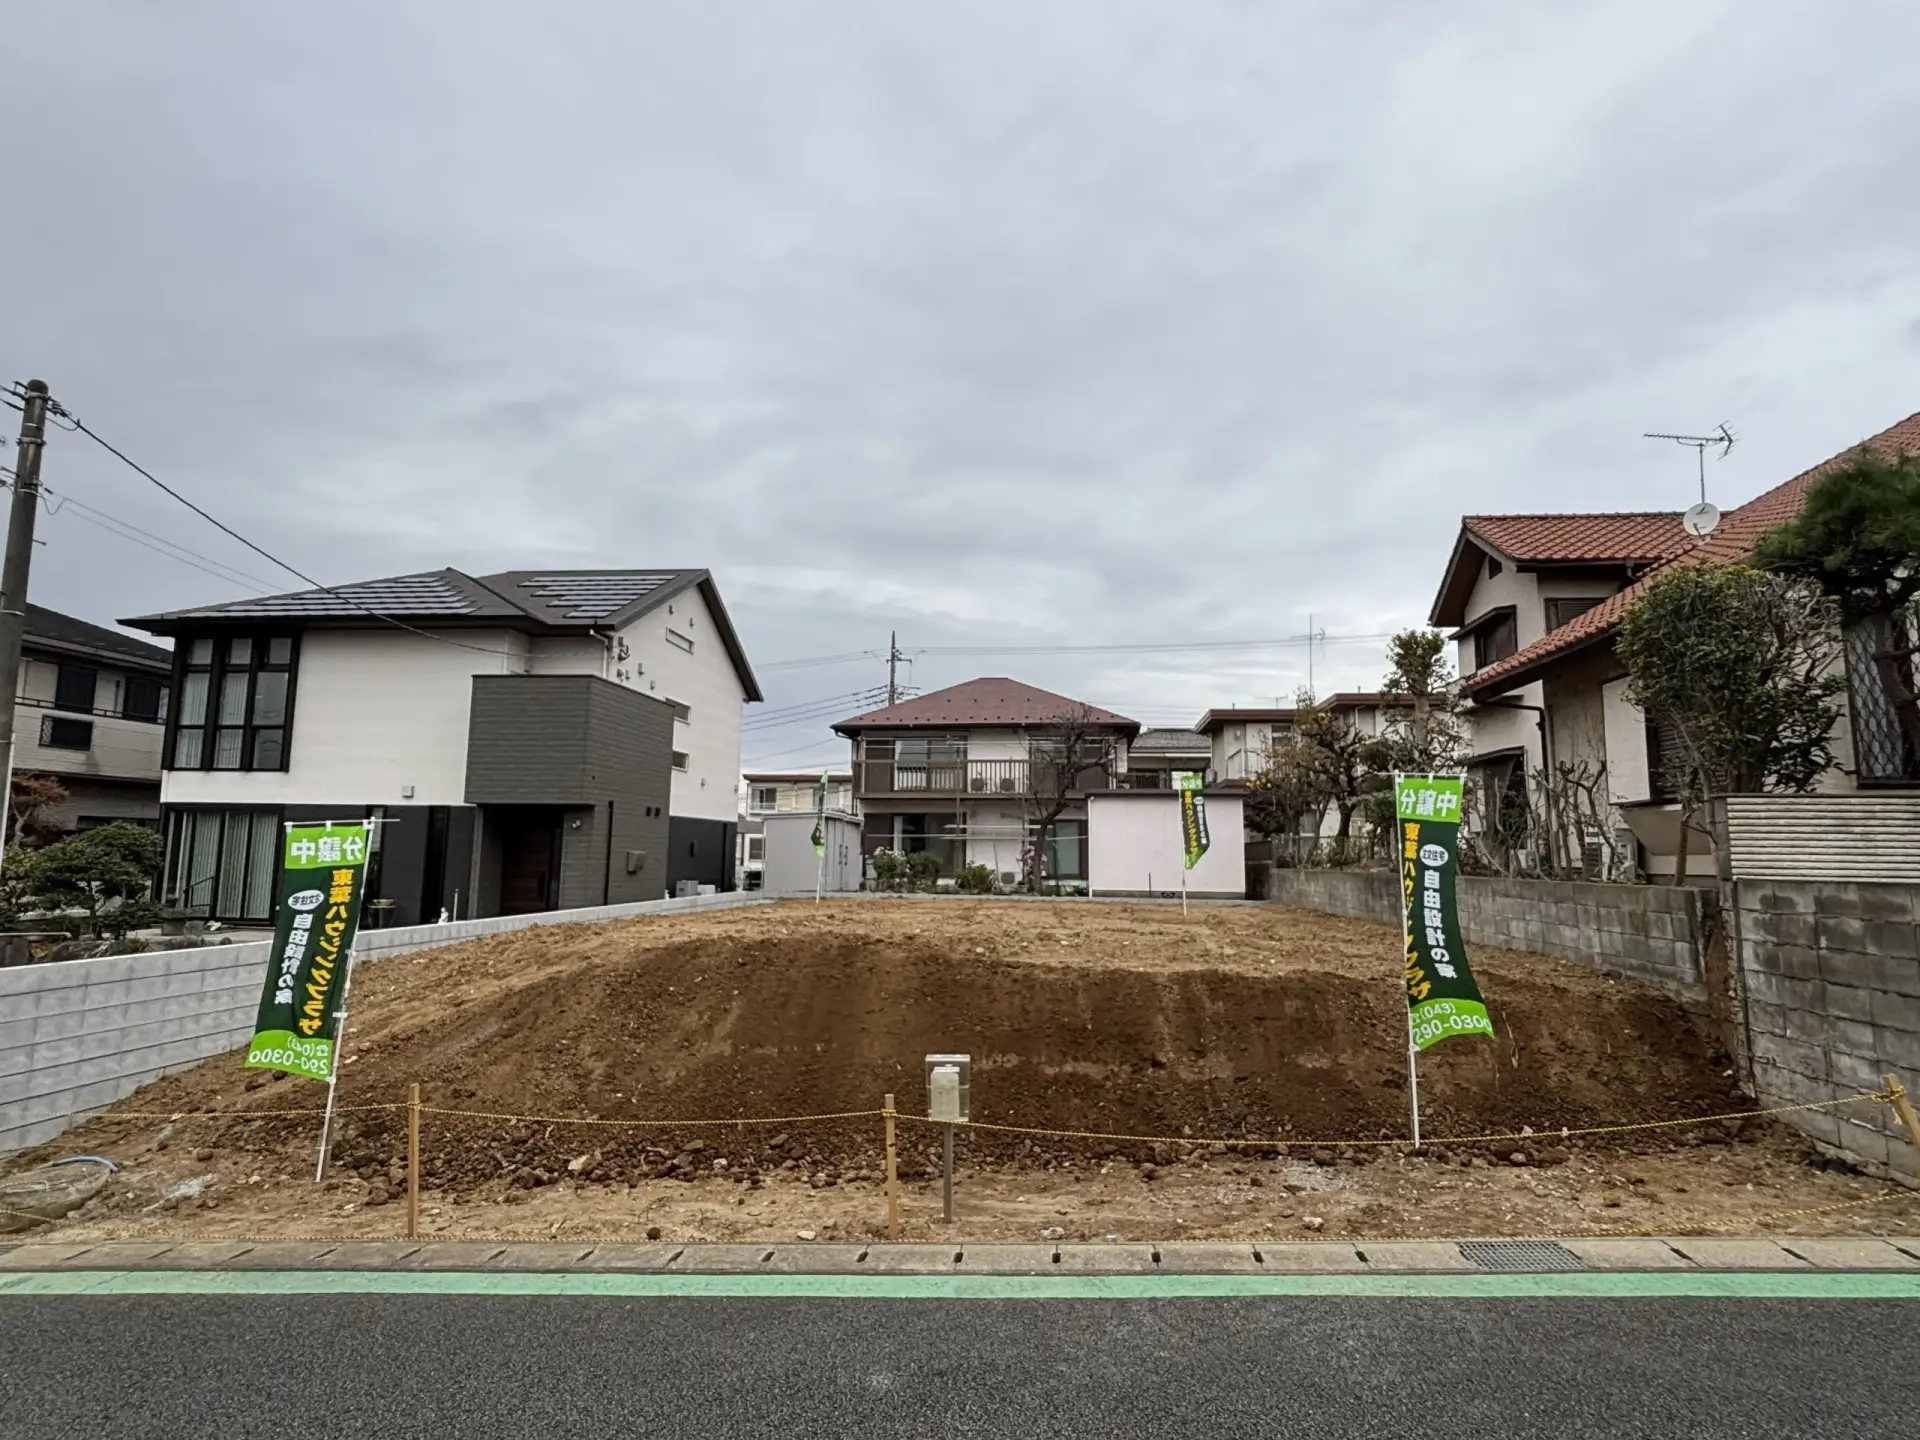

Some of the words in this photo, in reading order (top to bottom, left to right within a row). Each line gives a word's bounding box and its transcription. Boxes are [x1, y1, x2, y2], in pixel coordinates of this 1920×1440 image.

[1400, 789, 1458, 817] 分譲中
[1403, 822, 1432, 1000] 東葉ハウジプラザ
[1423, 869, 1458, 979] 自由設計の家
